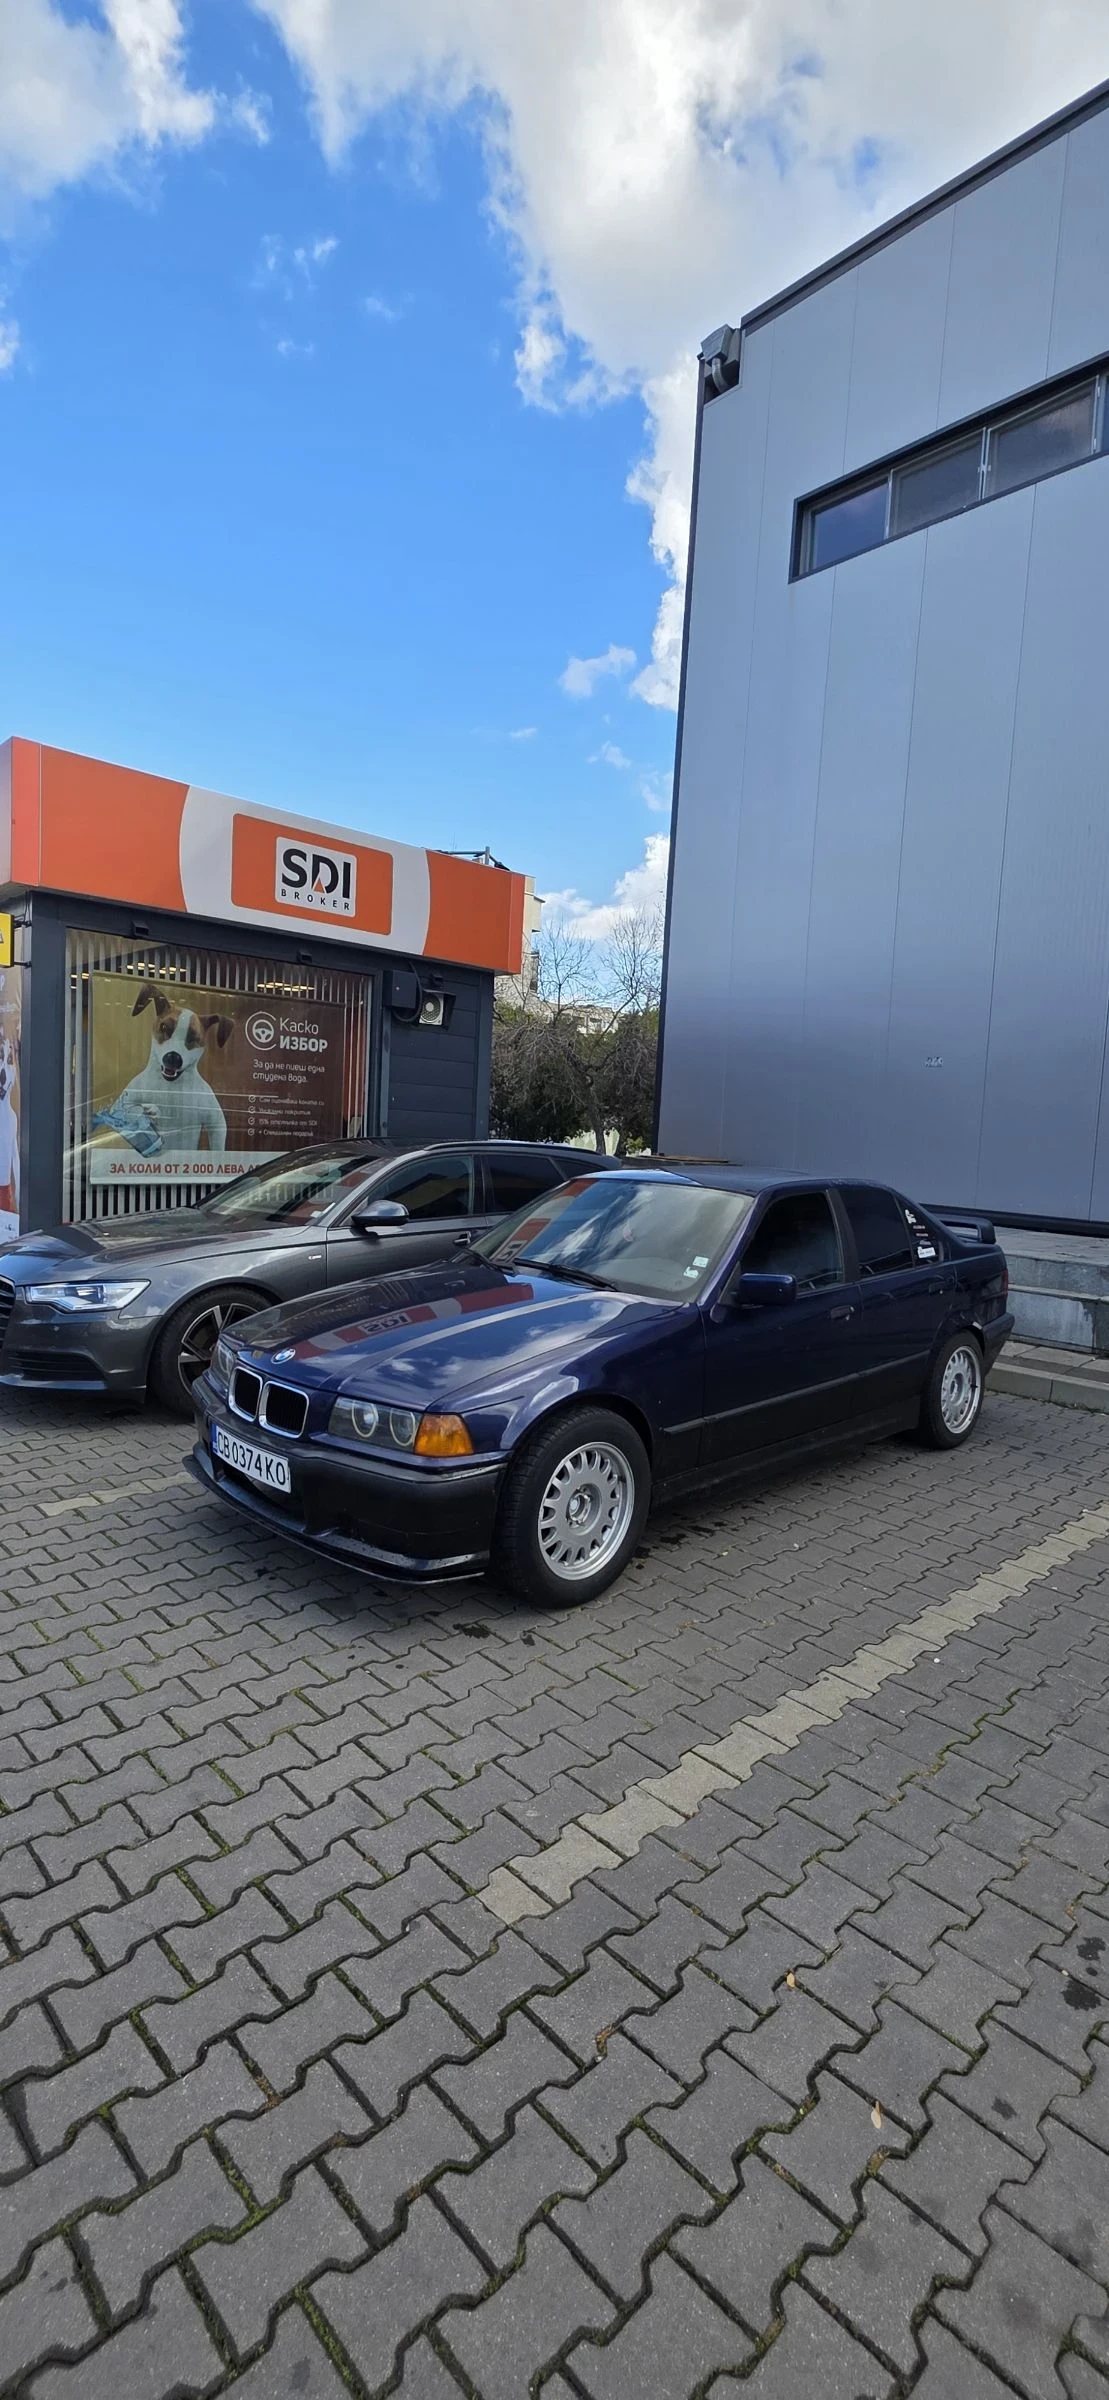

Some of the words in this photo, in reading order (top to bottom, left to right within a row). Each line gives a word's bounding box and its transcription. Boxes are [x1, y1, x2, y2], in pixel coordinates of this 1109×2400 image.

[282, 848, 351, 899] SDI
[281, 889, 350, 910] BROKER
[280, 1017, 319, 1035] Каско
[280, 1035, 328, 1052] ИЗБОР
[253, 1059, 263, 1068] За
[110, 1163, 126, 1174] ЗА
[129, 1163, 161, 1174] КОЛИ
[164, 1163, 179, 1174] ОТ
[182, 1163, 190, 1174] 2
[192, 1163, 213, 1174] 000
[216, 1163, 245, 1174] ЛЕВА
